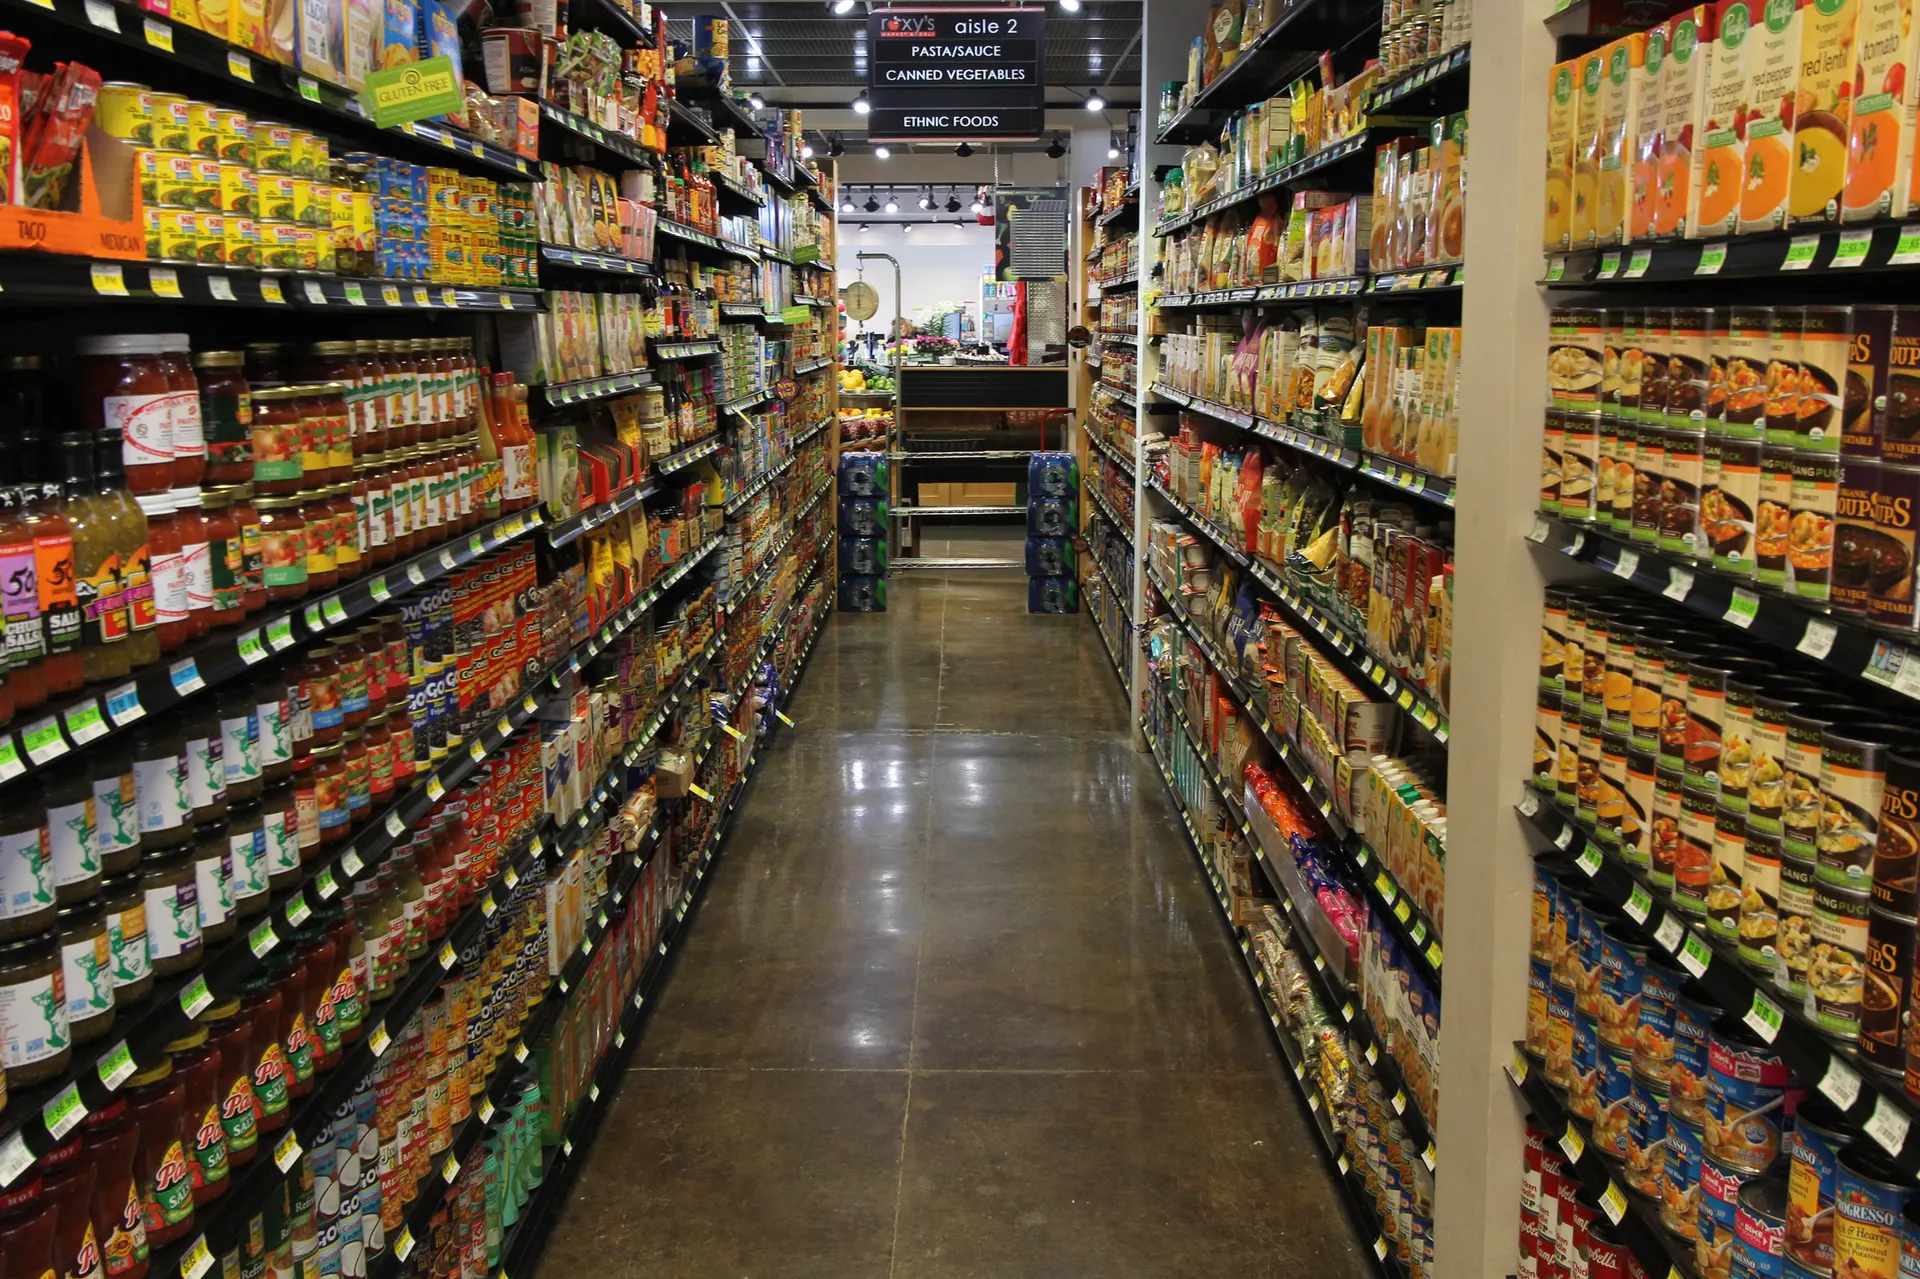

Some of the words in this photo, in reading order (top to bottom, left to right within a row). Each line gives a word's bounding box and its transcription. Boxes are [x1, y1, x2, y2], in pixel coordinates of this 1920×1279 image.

[955, 19, 999, 34] aisle
[1006, 19, 1018, 34] 2
[912, 46, 1001, 57] PASTA/SAUCE
[1863, 34, 1900, 62] tomato
[1801, 59, 1820, 77] red
[1822, 49, 1849, 73] lentil
[886, 69, 943, 80] CANNED
[946, 69, 1025, 80] VEGETABLES
[1752, 71, 1767, 87] red
[1767, 65, 1793, 84] pepper
[379, 82, 423, 103] GLUTEN
[424, 78, 449, 92] FREE
[1761, 85, 1786, 103] tomato
[903, 116, 949, 127] ETHNIC
[953, 116, 999, 127] FOODS
[17, 221, 46, 241] TACO
[100, 232, 140, 250] MEXICAN
[1744, 1223, 1763, 1238] DIME
[1856, 1226, 1892, 1245] Hearty
[1855, 1243, 1888, 1257] Roasted
